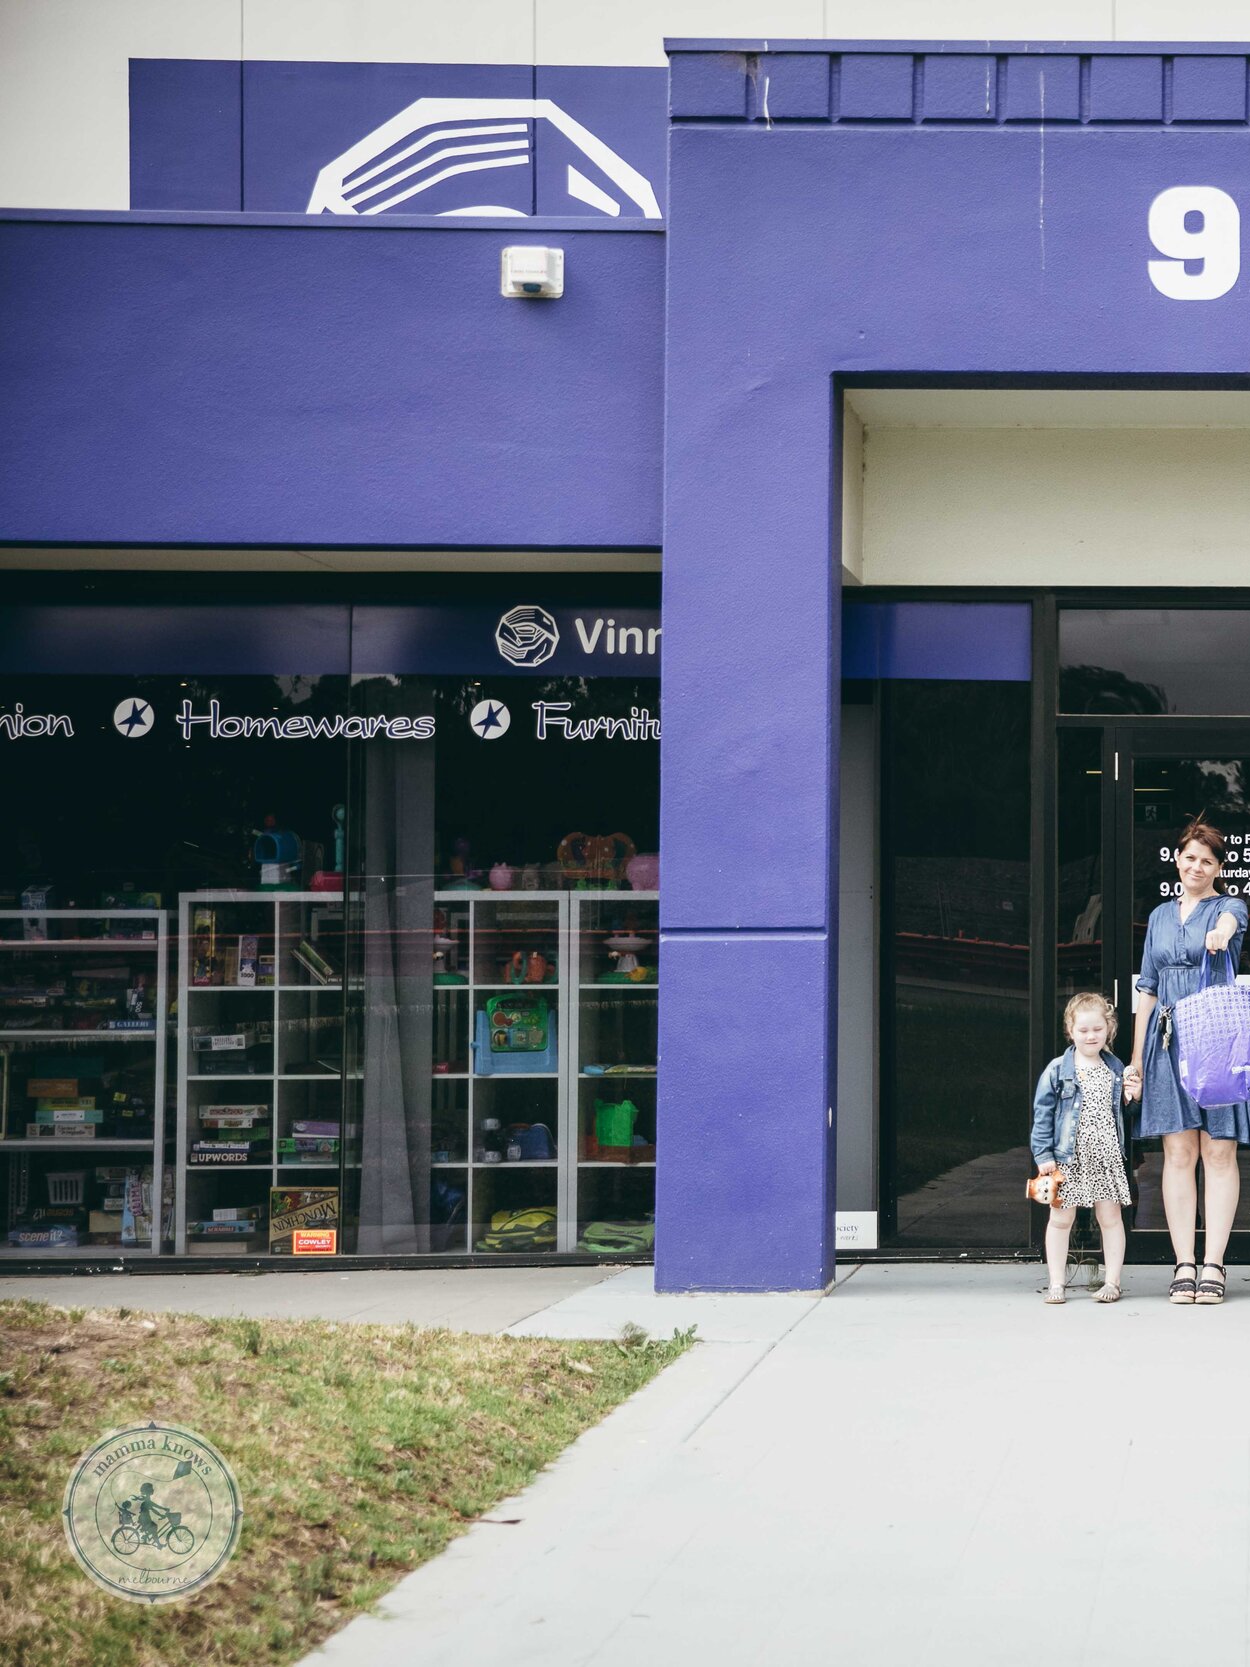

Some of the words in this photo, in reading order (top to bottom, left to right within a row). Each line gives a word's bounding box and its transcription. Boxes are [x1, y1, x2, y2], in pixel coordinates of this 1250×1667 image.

[176, 699, 436, 740] Homewares
[1230, 834, 1242, 845] to
[1226, 849, 1239, 863] o
[198, 1153, 248, 1162] UPWORDS
[272, 1200, 337, 1233] MUNCHKIN
[18, 1231, 49, 1242] scene
[50, 1230, 63, 1241] it?
